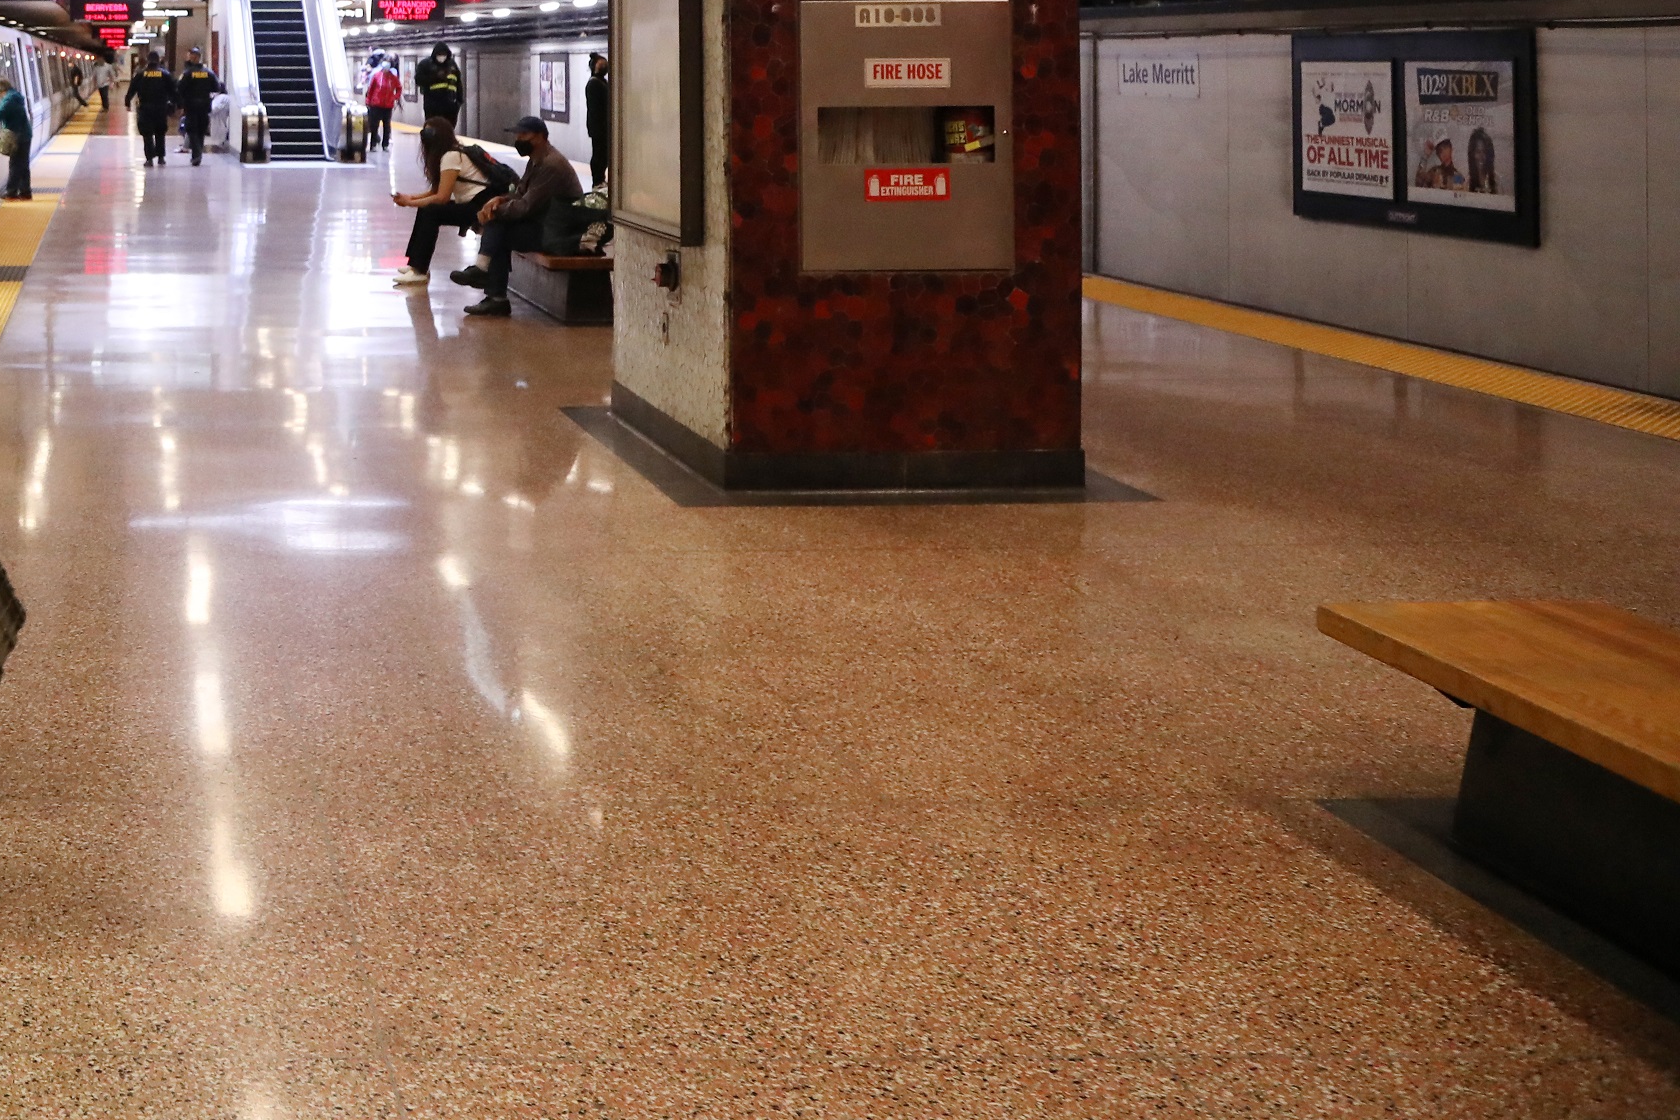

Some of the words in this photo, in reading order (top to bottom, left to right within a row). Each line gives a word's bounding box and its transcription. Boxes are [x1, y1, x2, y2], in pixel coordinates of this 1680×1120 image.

[379, 0, 395, 8] SAN
[397, 0, 437, 8] FRANCISCO
[393, 7, 412, 15] DALY
[415, 7, 432, 15] CITY
[873, 63, 902, 80] FIRE
[907, 63, 943, 80] HOSE
[1123, 62, 1148, 84] Lake
[1152, 62, 1195, 85] Merritt
[1447, 74, 1496, 97] KBLX
[1334, 99, 1381, 114] MORMON
[1424, 108, 1451, 123] R&B
[1306, 134, 1320, 145] THE
[1321, 135, 1355, 147] FUNNIEST
[1355, 136, 1389, 149] MUSICAL
[1306, 145, 1326, 165] OF
[1328, 147, 1354, 167] ALL
[1355, 148, 1389, 170] TIME
[890, 174, 924, 186] FIRE
[1321, 170, 1329, 178] BY
[1330, 170, 1354, 180] POPULAR
[1355, 173, 1378, 183] DEMAND
[881, 185, 934, 197] EXTINGUISHER
